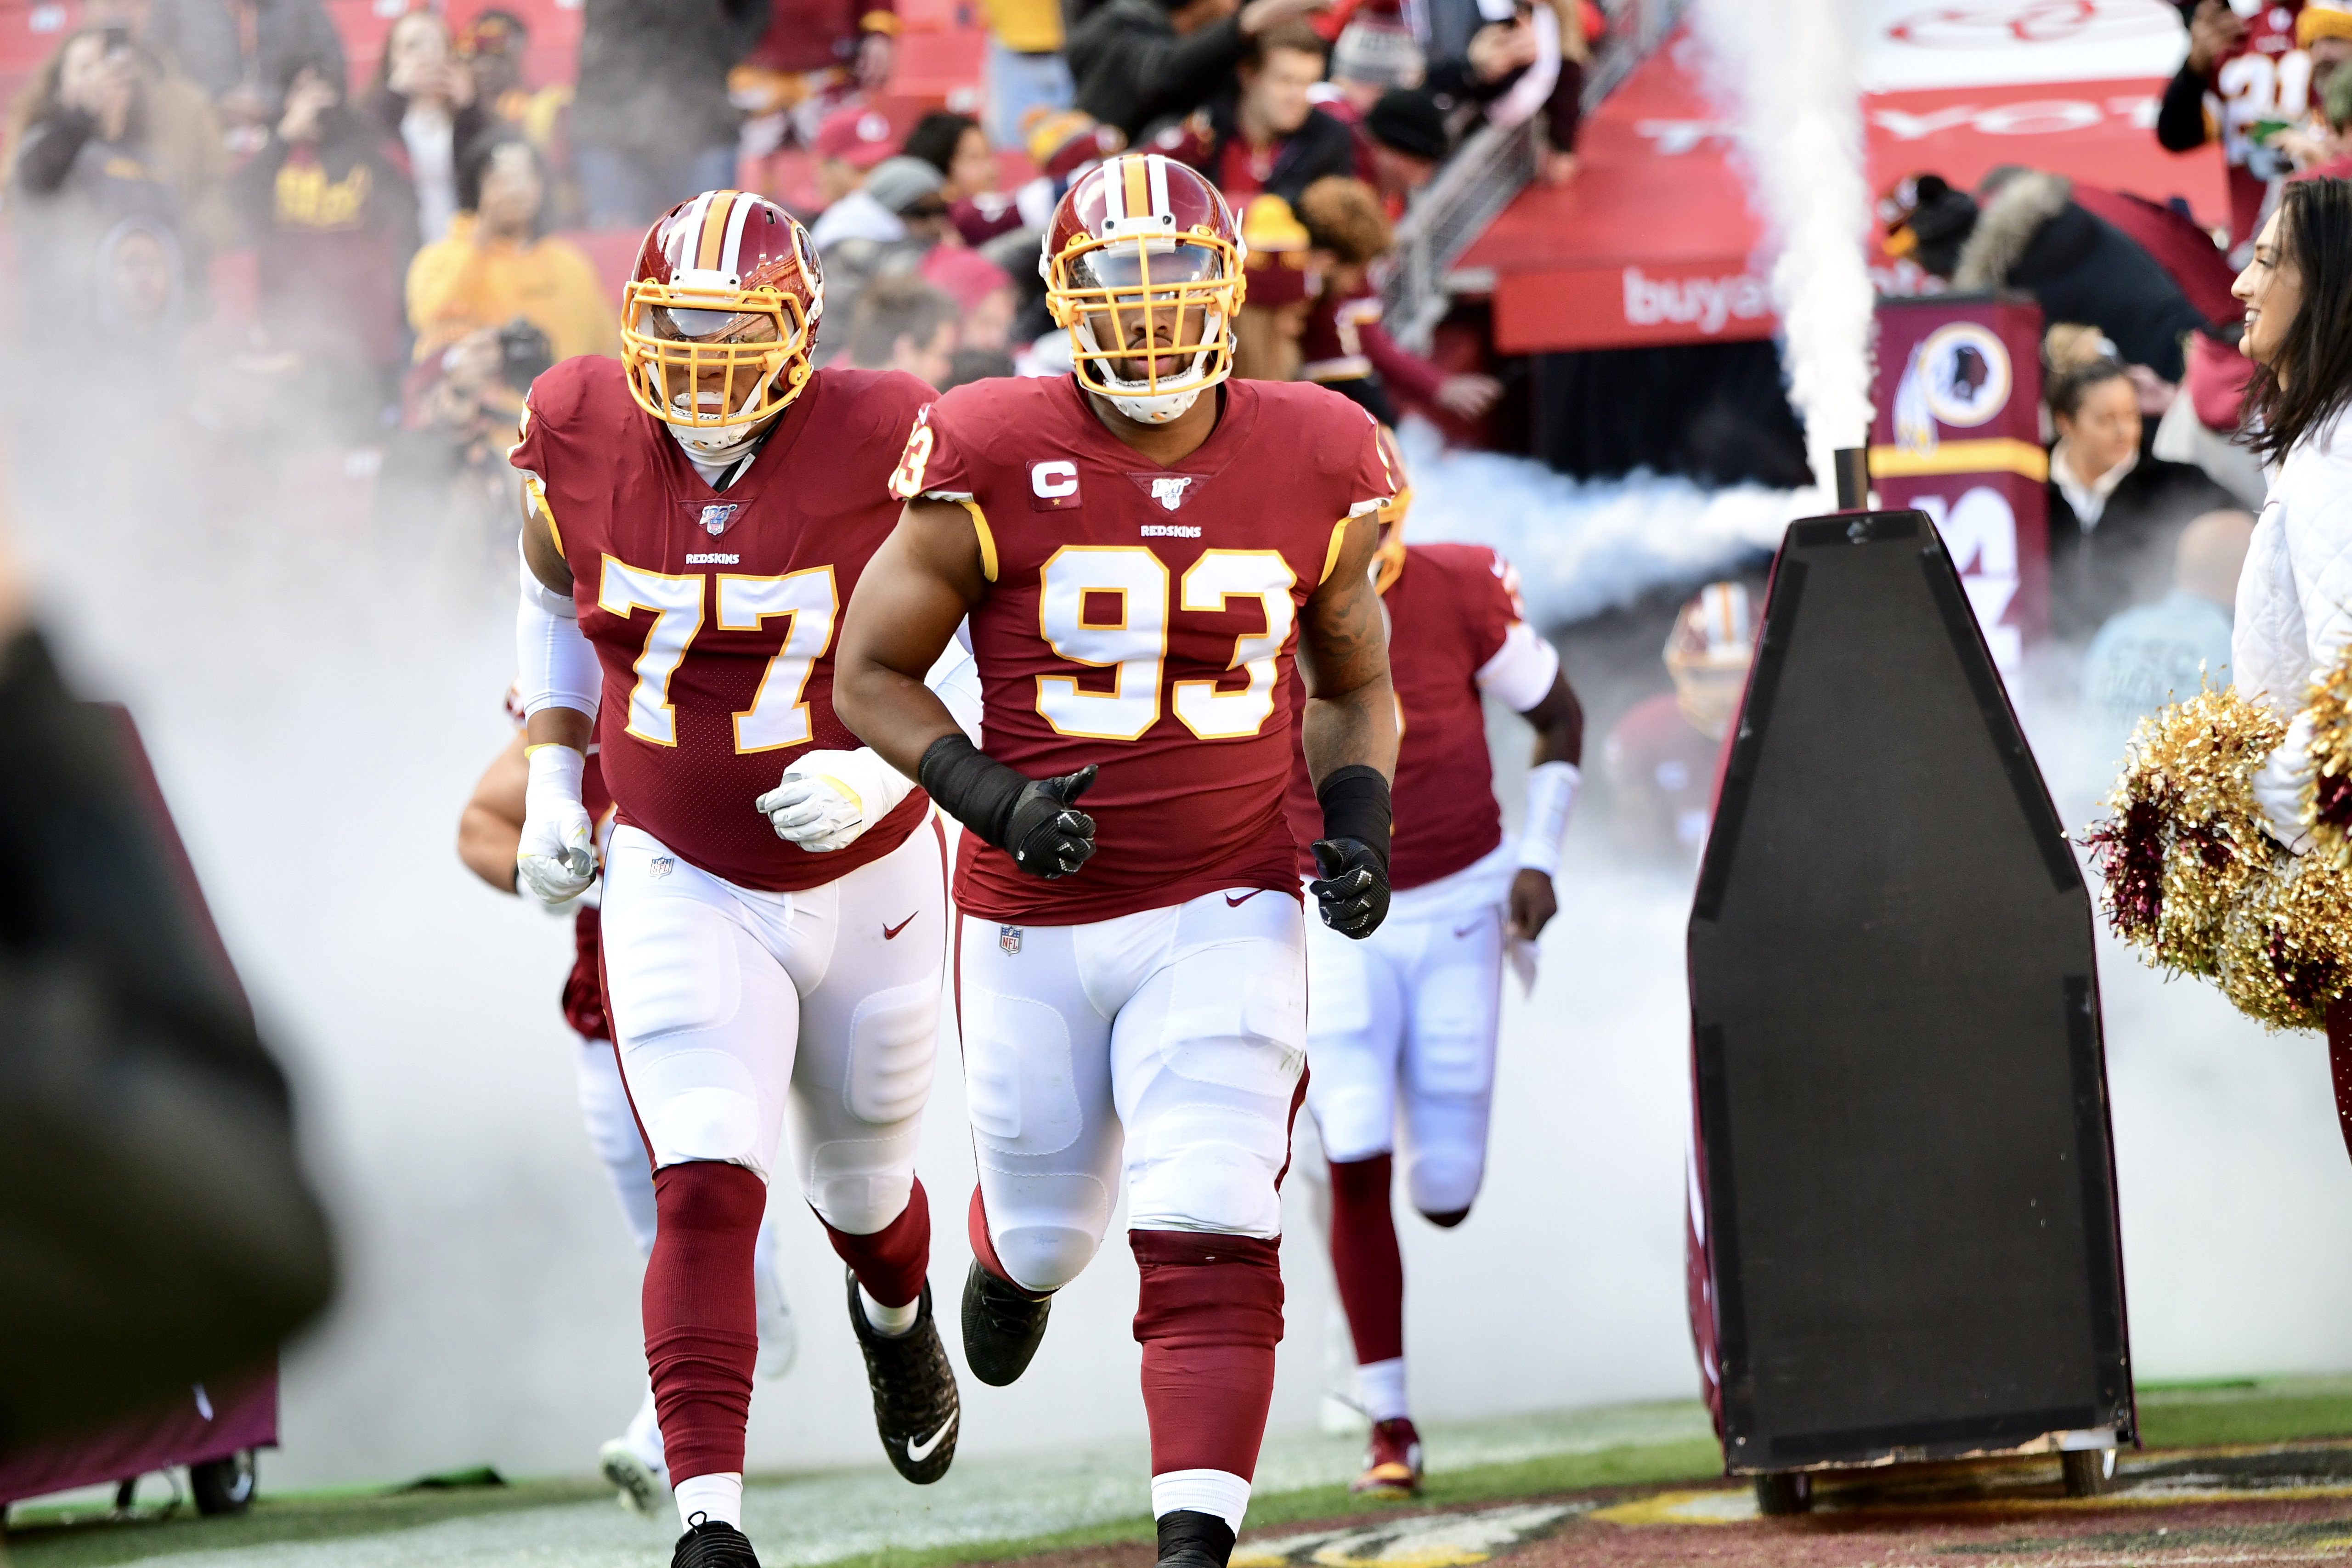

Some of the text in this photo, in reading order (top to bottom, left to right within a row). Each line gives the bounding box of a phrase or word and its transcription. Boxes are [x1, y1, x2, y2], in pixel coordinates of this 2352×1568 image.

[1031, 461, 1077, 498] C
[1141, 525, 1202, 538] REDSKINS
[686, 553, 740, 564] REDSKINS
[1035, 545, 1297, 741] 93
[598, 553, 840, 754] 77
[652, 864, 668, 873] NFL
[1002, 937, 1018, 950] NFL
